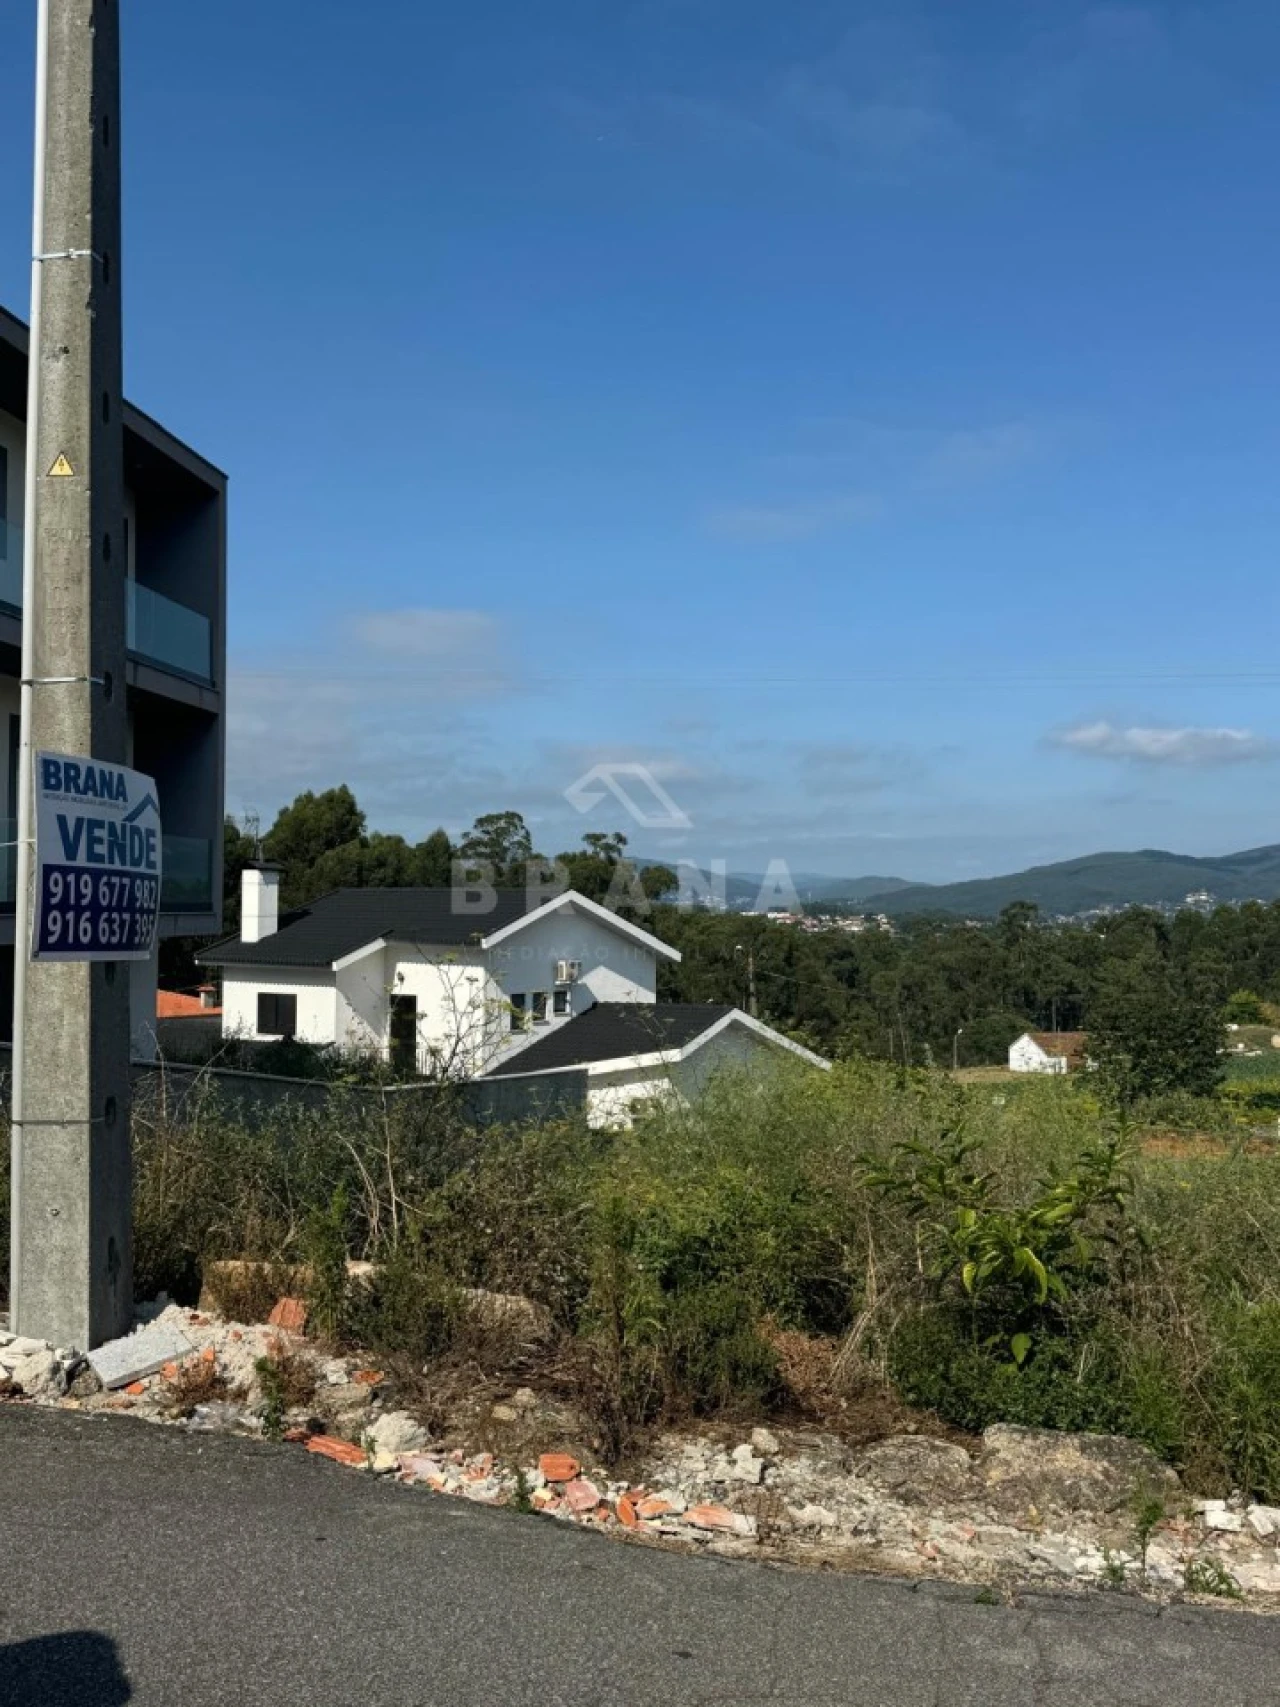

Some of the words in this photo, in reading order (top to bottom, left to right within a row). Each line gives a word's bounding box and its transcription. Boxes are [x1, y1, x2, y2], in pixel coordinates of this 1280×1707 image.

[42, 759, 128, 803] BRANA
[56, 814, 157, 870] VENDE
[49, 872, 93, 906] 919
[98, 875, 131, 909] 677
[47, 910, 92, 944] 916
[98, 911, 131, 945] 637
